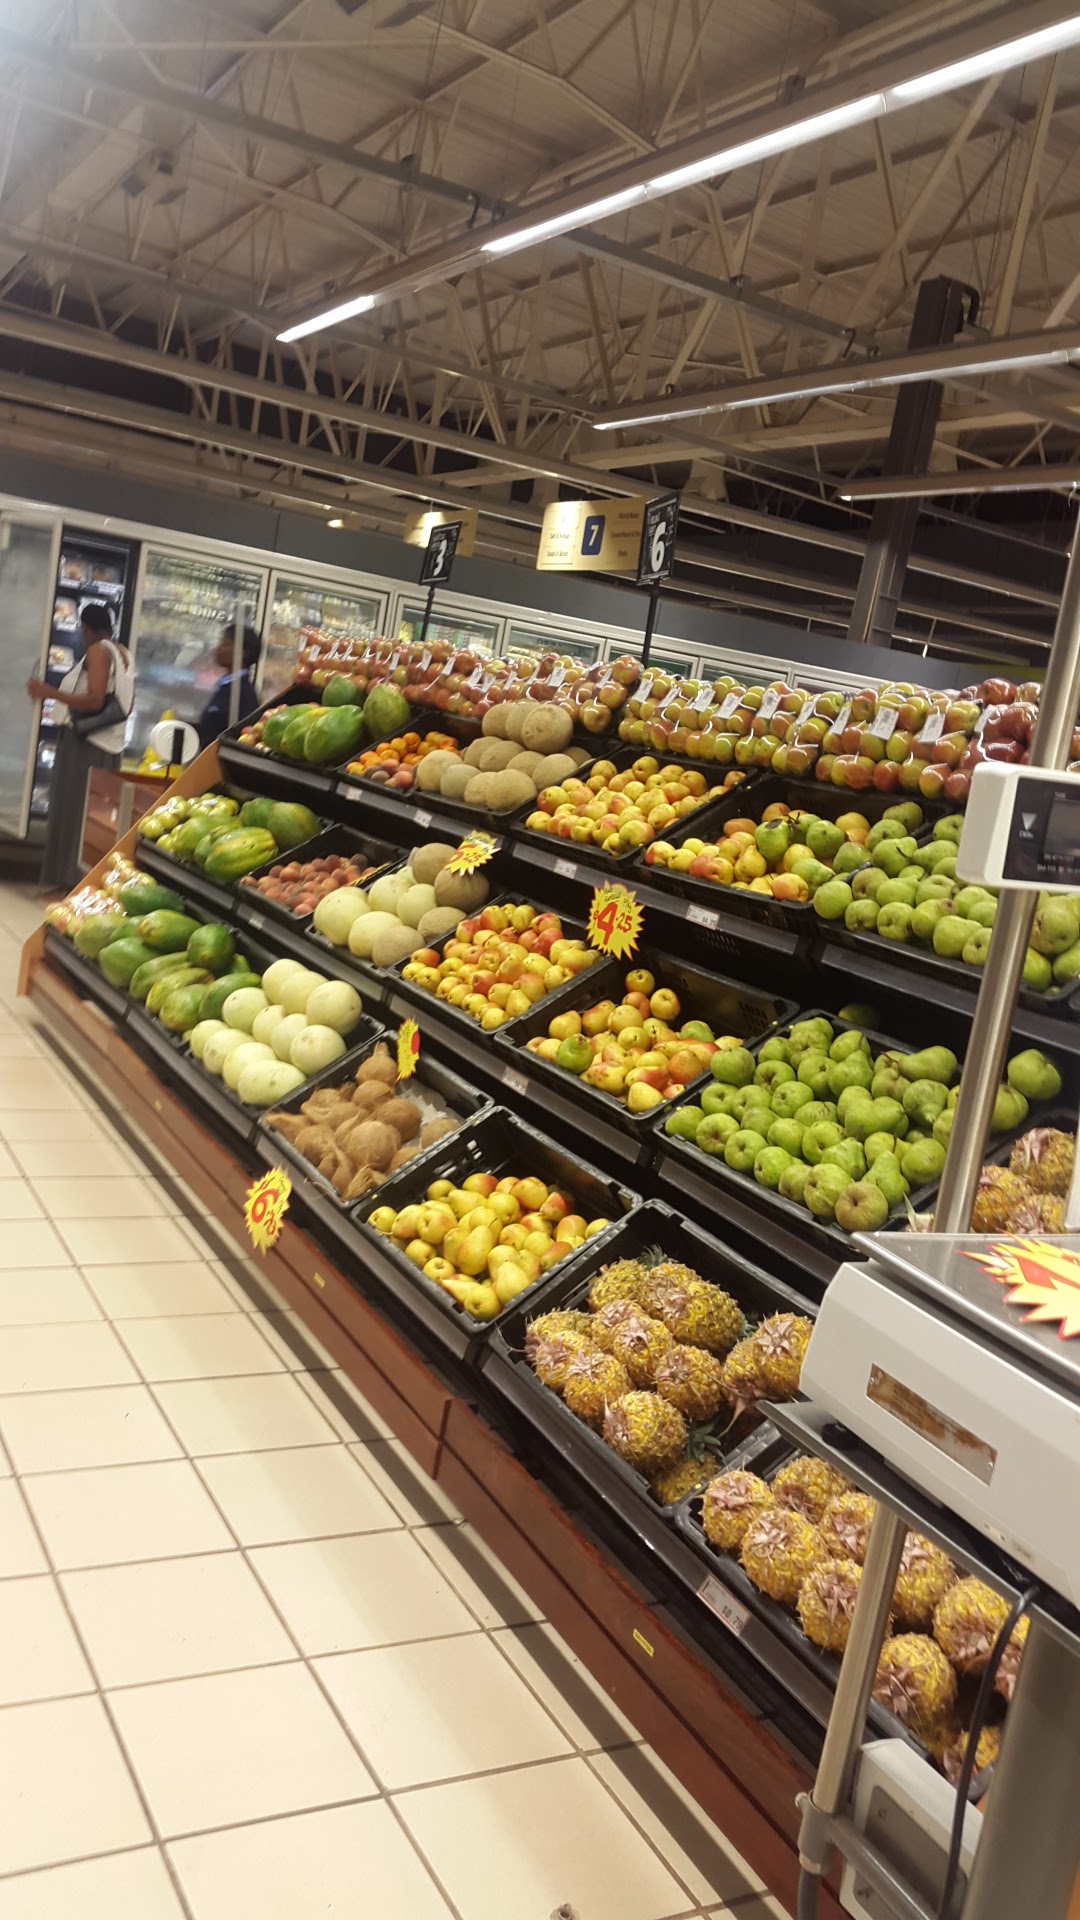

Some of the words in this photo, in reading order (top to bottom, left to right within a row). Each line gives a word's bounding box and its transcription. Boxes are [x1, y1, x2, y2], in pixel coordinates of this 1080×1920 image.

[588, 525, 599, 546] 7
[651, 521, 666, 572] 6
[432, 539, 448, 577] 3
